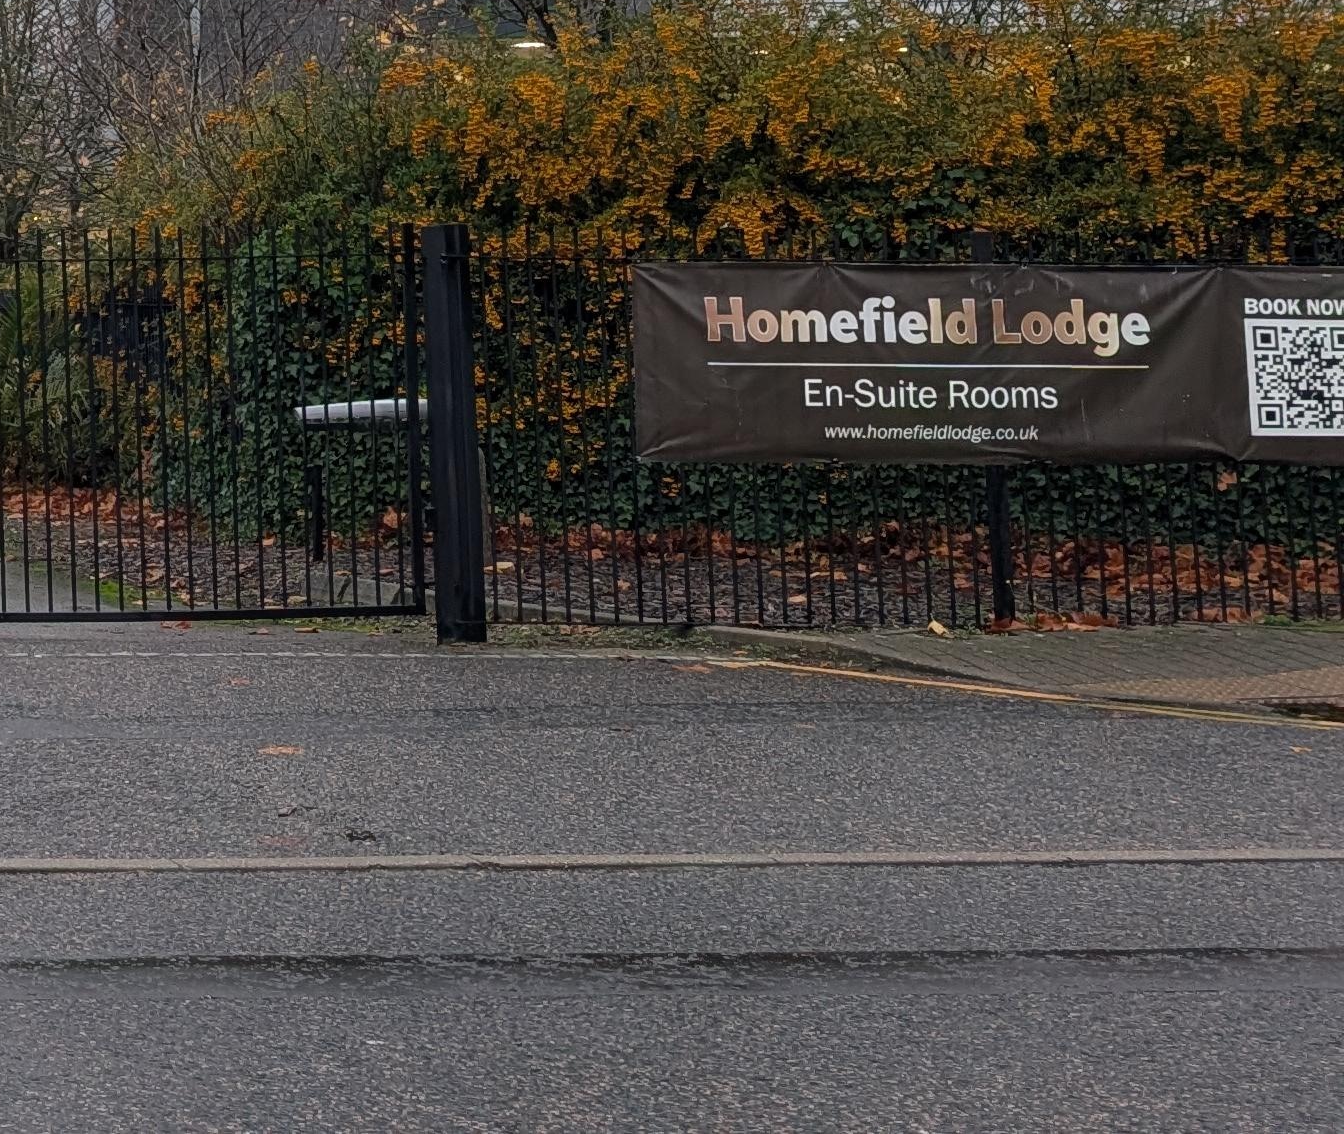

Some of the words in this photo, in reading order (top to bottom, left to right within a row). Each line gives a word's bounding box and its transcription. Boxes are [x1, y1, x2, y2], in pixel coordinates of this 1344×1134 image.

[1243, 297, 1302, 316] BOOK
[703, 295, 978, 346] Homefield
[991, 298, 1151, 357] Lodge
[803, 378, 937, 410] En-Suite
[948, 379, 1059, 410] Rooms
[824, 423, 1039, 444] www.homefieldlodge.co.uk
